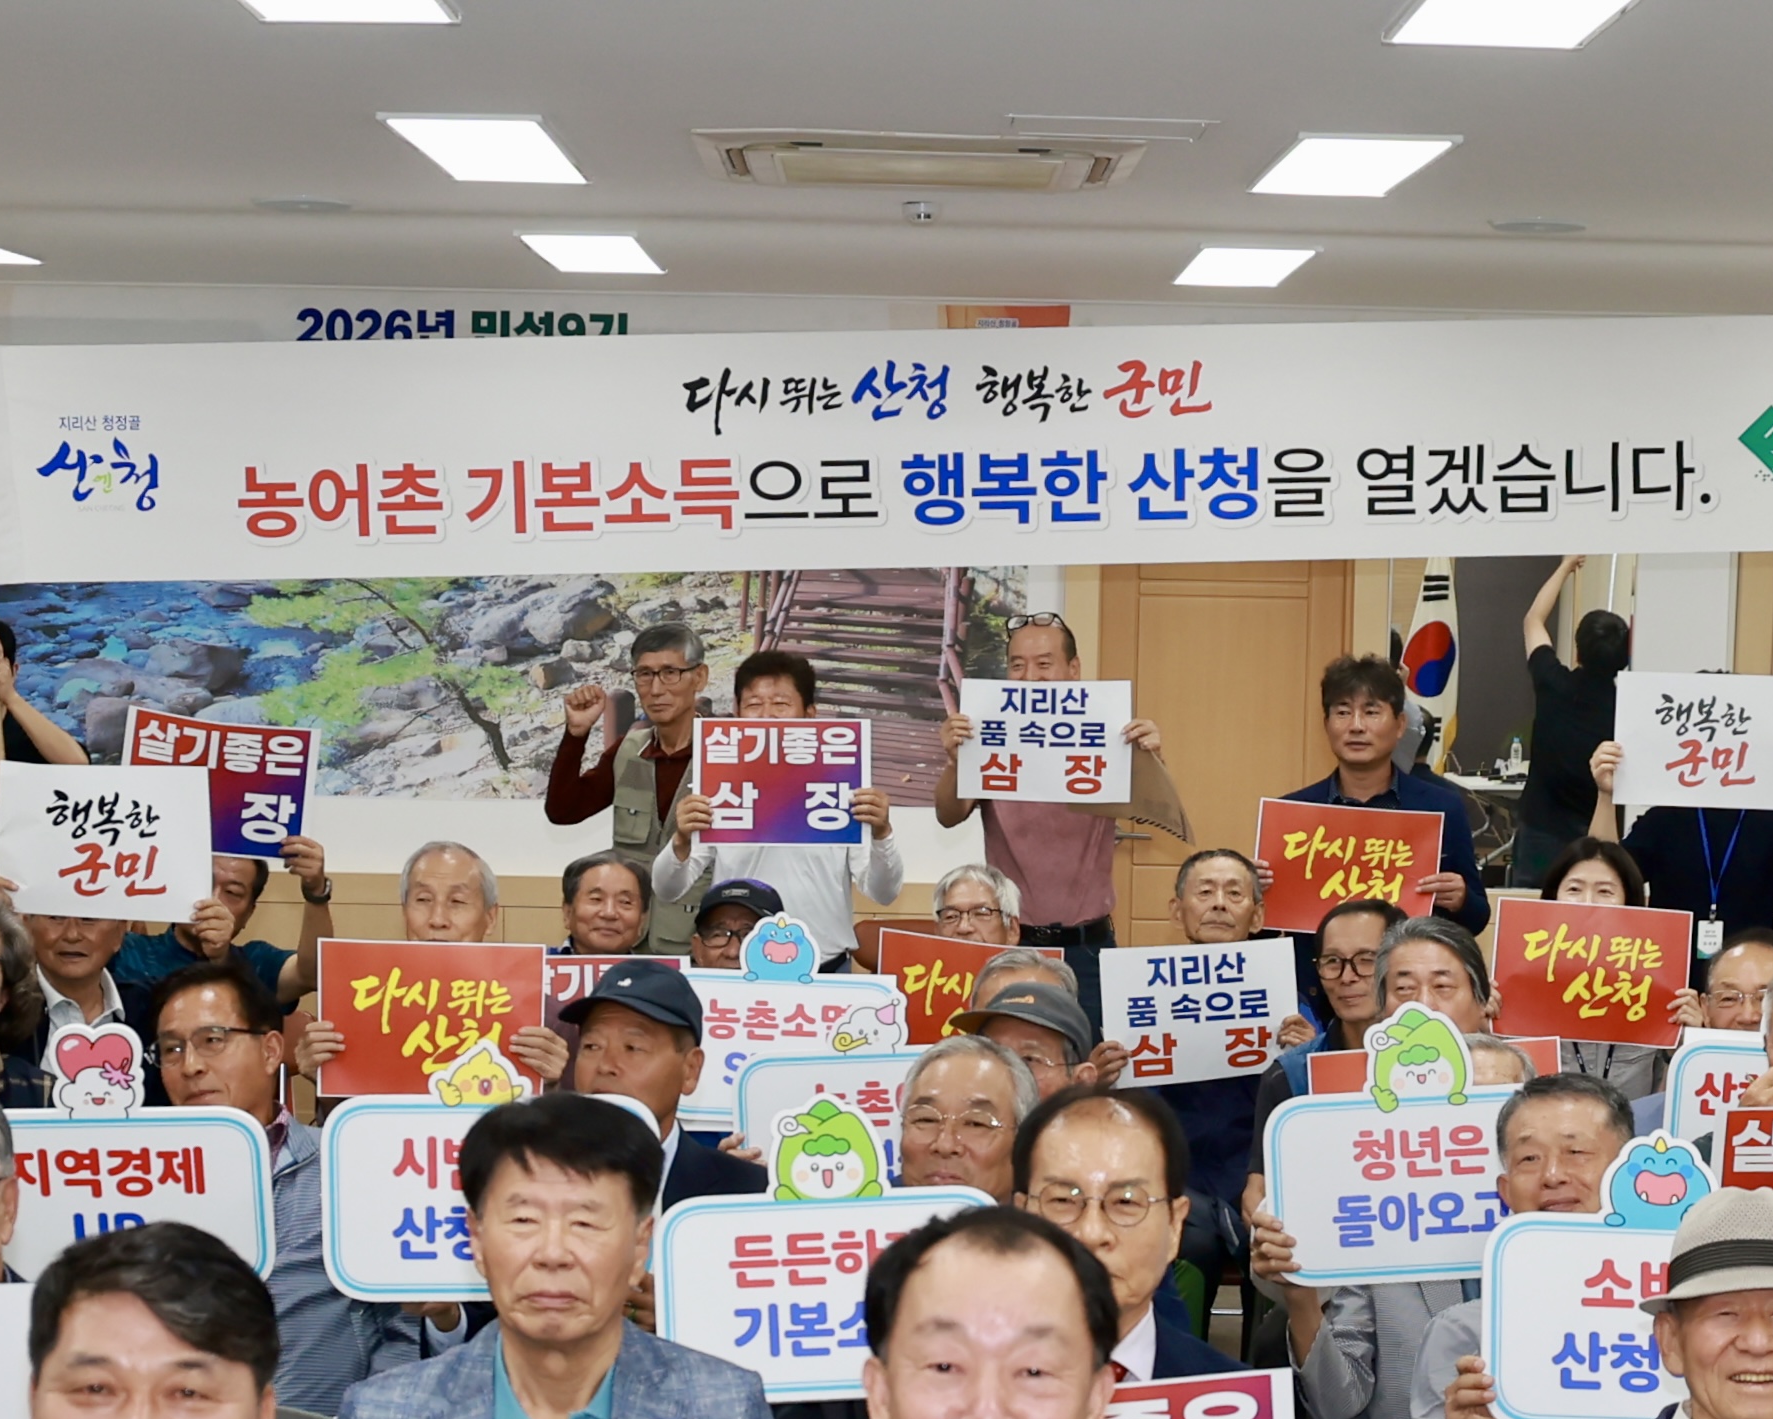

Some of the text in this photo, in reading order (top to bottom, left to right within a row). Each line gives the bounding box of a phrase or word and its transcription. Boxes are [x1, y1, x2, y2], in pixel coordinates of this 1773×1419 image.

[59, 415, 141, 431] 지리산 청정골
[683, 359, 1214, 435] 다시 뛰는 산청 행복한 군민
[238, 440, 1714, 538] 농어촌 기본소득으로 행복한 산청을 열겠습니다.
[1000, 687, 1088, 716] 지리산
[1655, 693, 1752, 742] 행복한
[137, 719, 305, 777] 살기좋은
[704, 726, 858, 766] 살기좋은
[980, 720, 1106, 748] 품 속으로
[980, 754, 1107, 795] 삼 장
[1665, 739, 1756, 787] 군민
[46, 790, 161, 847] 행복한
[240, 792, 299, 844] 장
[710, 782, 856, 831] 삼 장
[58, 843, 168, 897] 군민
[1282, 825, 1414, 880] 다시 뛰는
[1147, 951, 1246, 987] 지리산
[1523, 923, 1664, 983] 다시 뛰는
[350, 967, 438, 1035] 다시
[447, 979, 514, 1018] 뛰는
[903, 959, 973, 1016] 다시
[1127, 989, 1270, 1028] 품 속으로
[1562, 966, 1653, 1022] 산청
[1130, 1026, 1273, 1077] 삼 장
[15, 1146, 206, 1198] 지역경제
[1353, 1124, 1489, 1182] 청년은
[1332, 1190, 1510, 1248] 돌아오고
[729, 1229, 910, 1289] 든든하
[735, 1301, 868, 1358] 기본소
